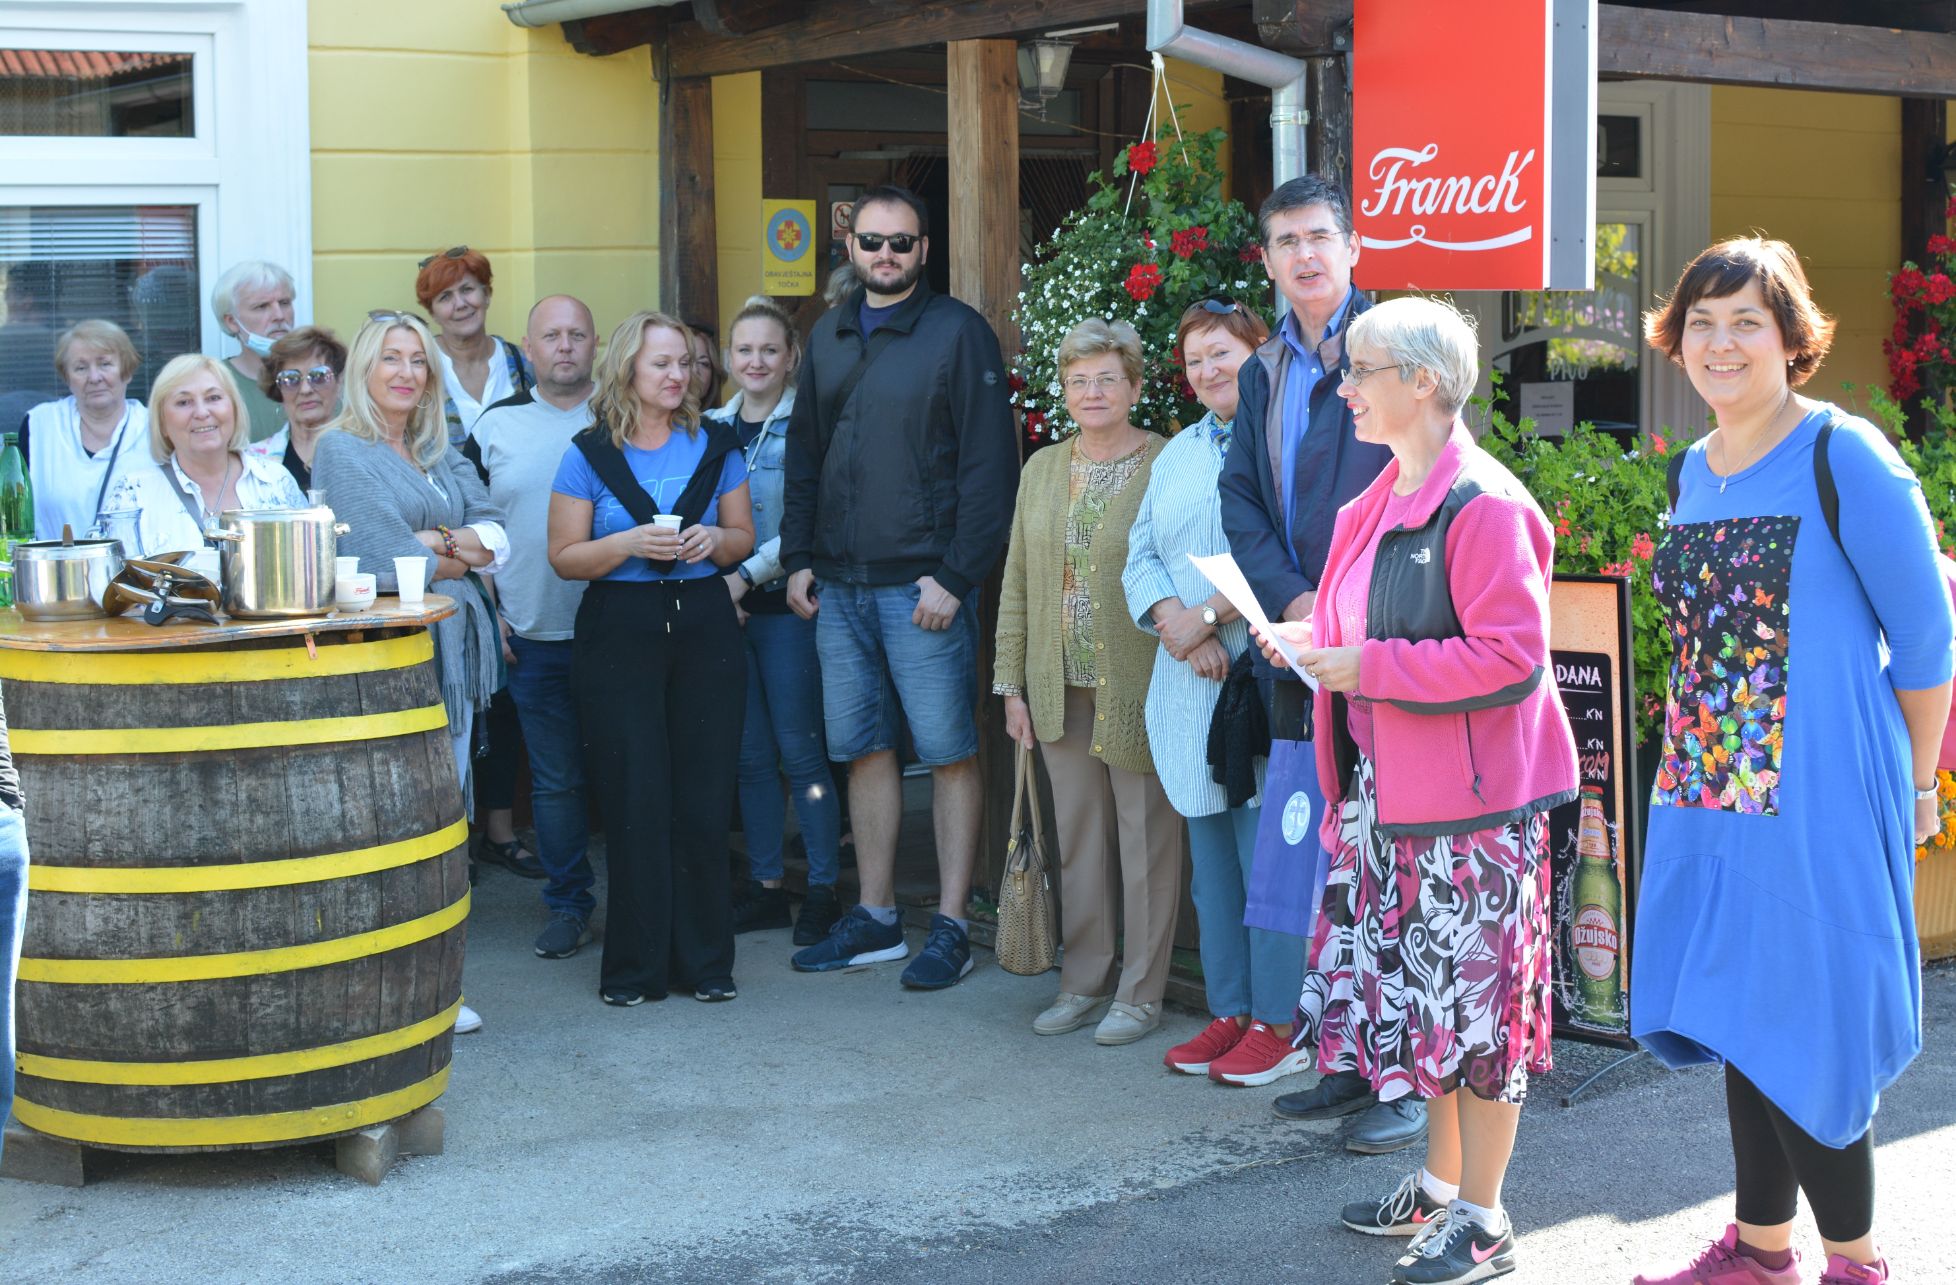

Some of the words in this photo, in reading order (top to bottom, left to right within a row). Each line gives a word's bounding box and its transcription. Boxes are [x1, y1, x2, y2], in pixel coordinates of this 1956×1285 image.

[1361, 143, 1536, 216] Franck
[1556, 664, 1602, 687] DANA
[1575, 926, 1617, 950] Ožujsko
